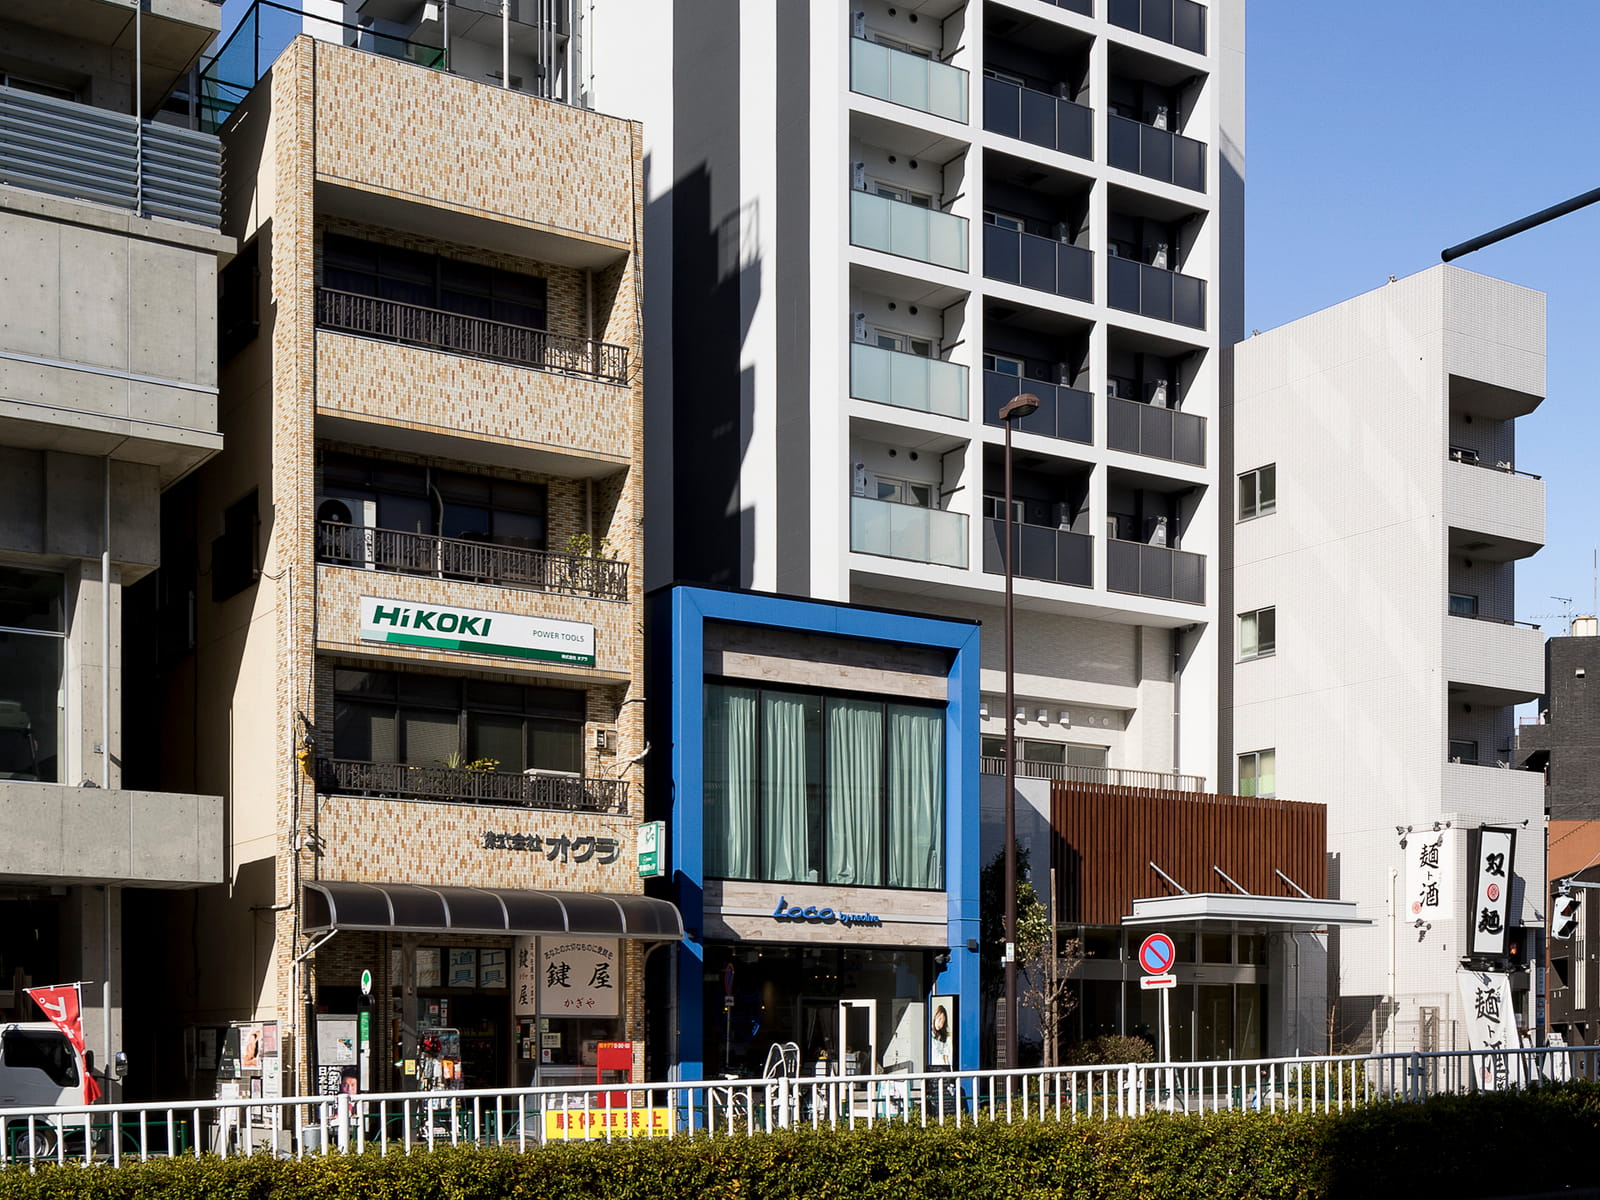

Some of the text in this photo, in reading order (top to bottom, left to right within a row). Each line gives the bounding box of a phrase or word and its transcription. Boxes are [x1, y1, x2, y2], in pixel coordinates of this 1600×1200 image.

[372, 604, 492, 637] HiKOKI
[532, 629, 585, 643] POWER TOOLS
[563, 997, 596, 1009] かぎや
